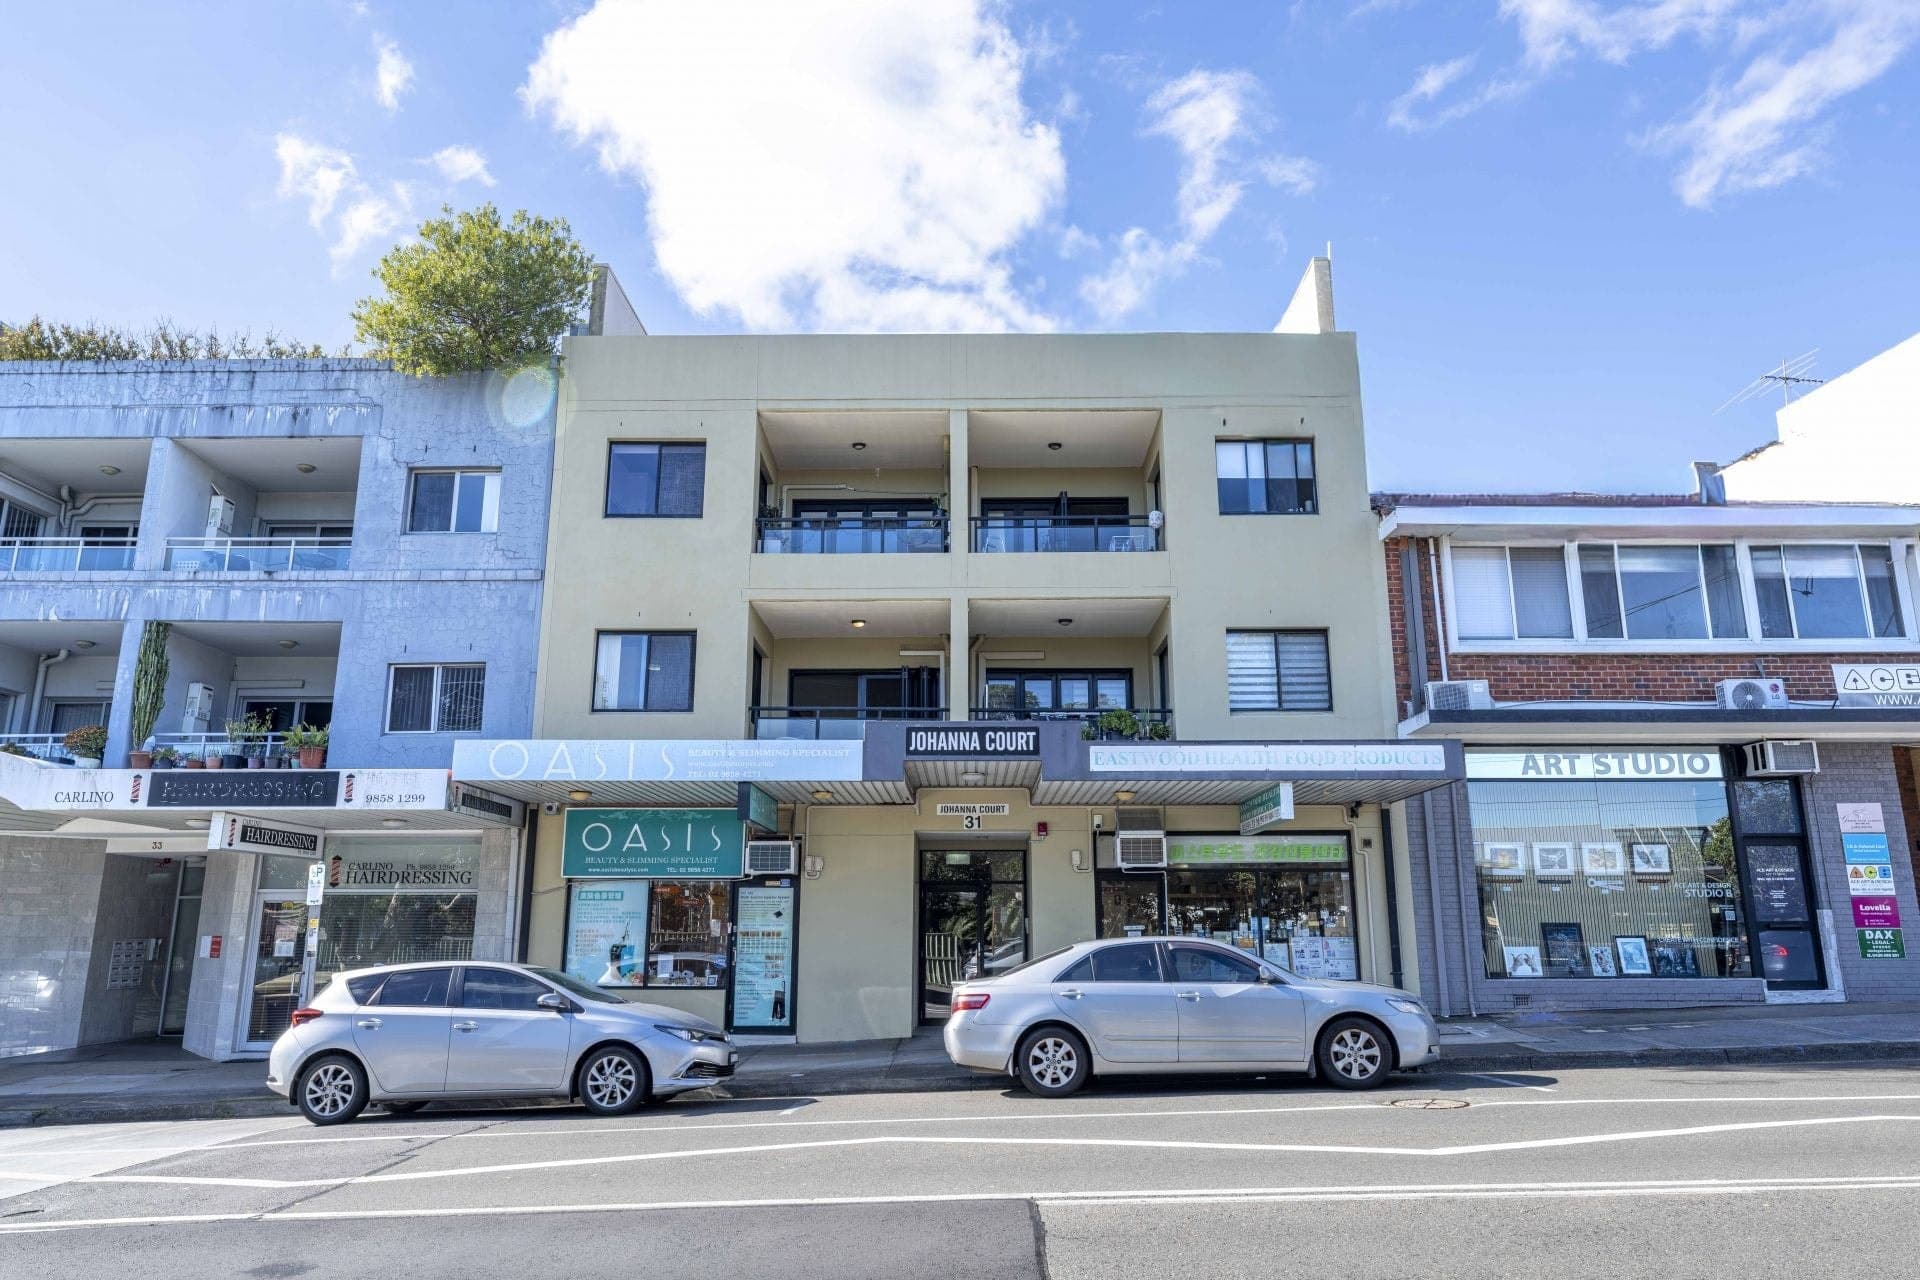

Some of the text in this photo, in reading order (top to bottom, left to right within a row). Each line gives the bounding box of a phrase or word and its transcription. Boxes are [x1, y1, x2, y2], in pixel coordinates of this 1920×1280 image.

[909, 731, 1036, 751] JOHANNA COURT
[792, 749, 848, 757] SPECIALIST
[1093, 750, 1442, 767] EASTWOOD HEALTH FOOD PRODUCTS
[489, 741, 674, 780] OASIS
[1522, 753, 1711, 776] ART STUDIO
[54, 791, 114, 803] CARLINO
[365, 794, 425, 803] 9858 1299
[940, 805, 1005, 814] JOHANNA COURT
[964, 815, 981, 829] 31
[246, 827, 315, 850] HAIRDRESSING
[582, 822, 721, 852] OASIS
[151, 841, 163, 850] 33
[585, 856, 718, 864] BEAUTY & SLIMMING SPECIALIST
[348, 862, 394, 871] CARLINO
[346, 870, 473, 885] HAIRDRESSING
[1684, 889, 1724, 898] STUDIO
[1865, 930, 1894, 940] DAX
